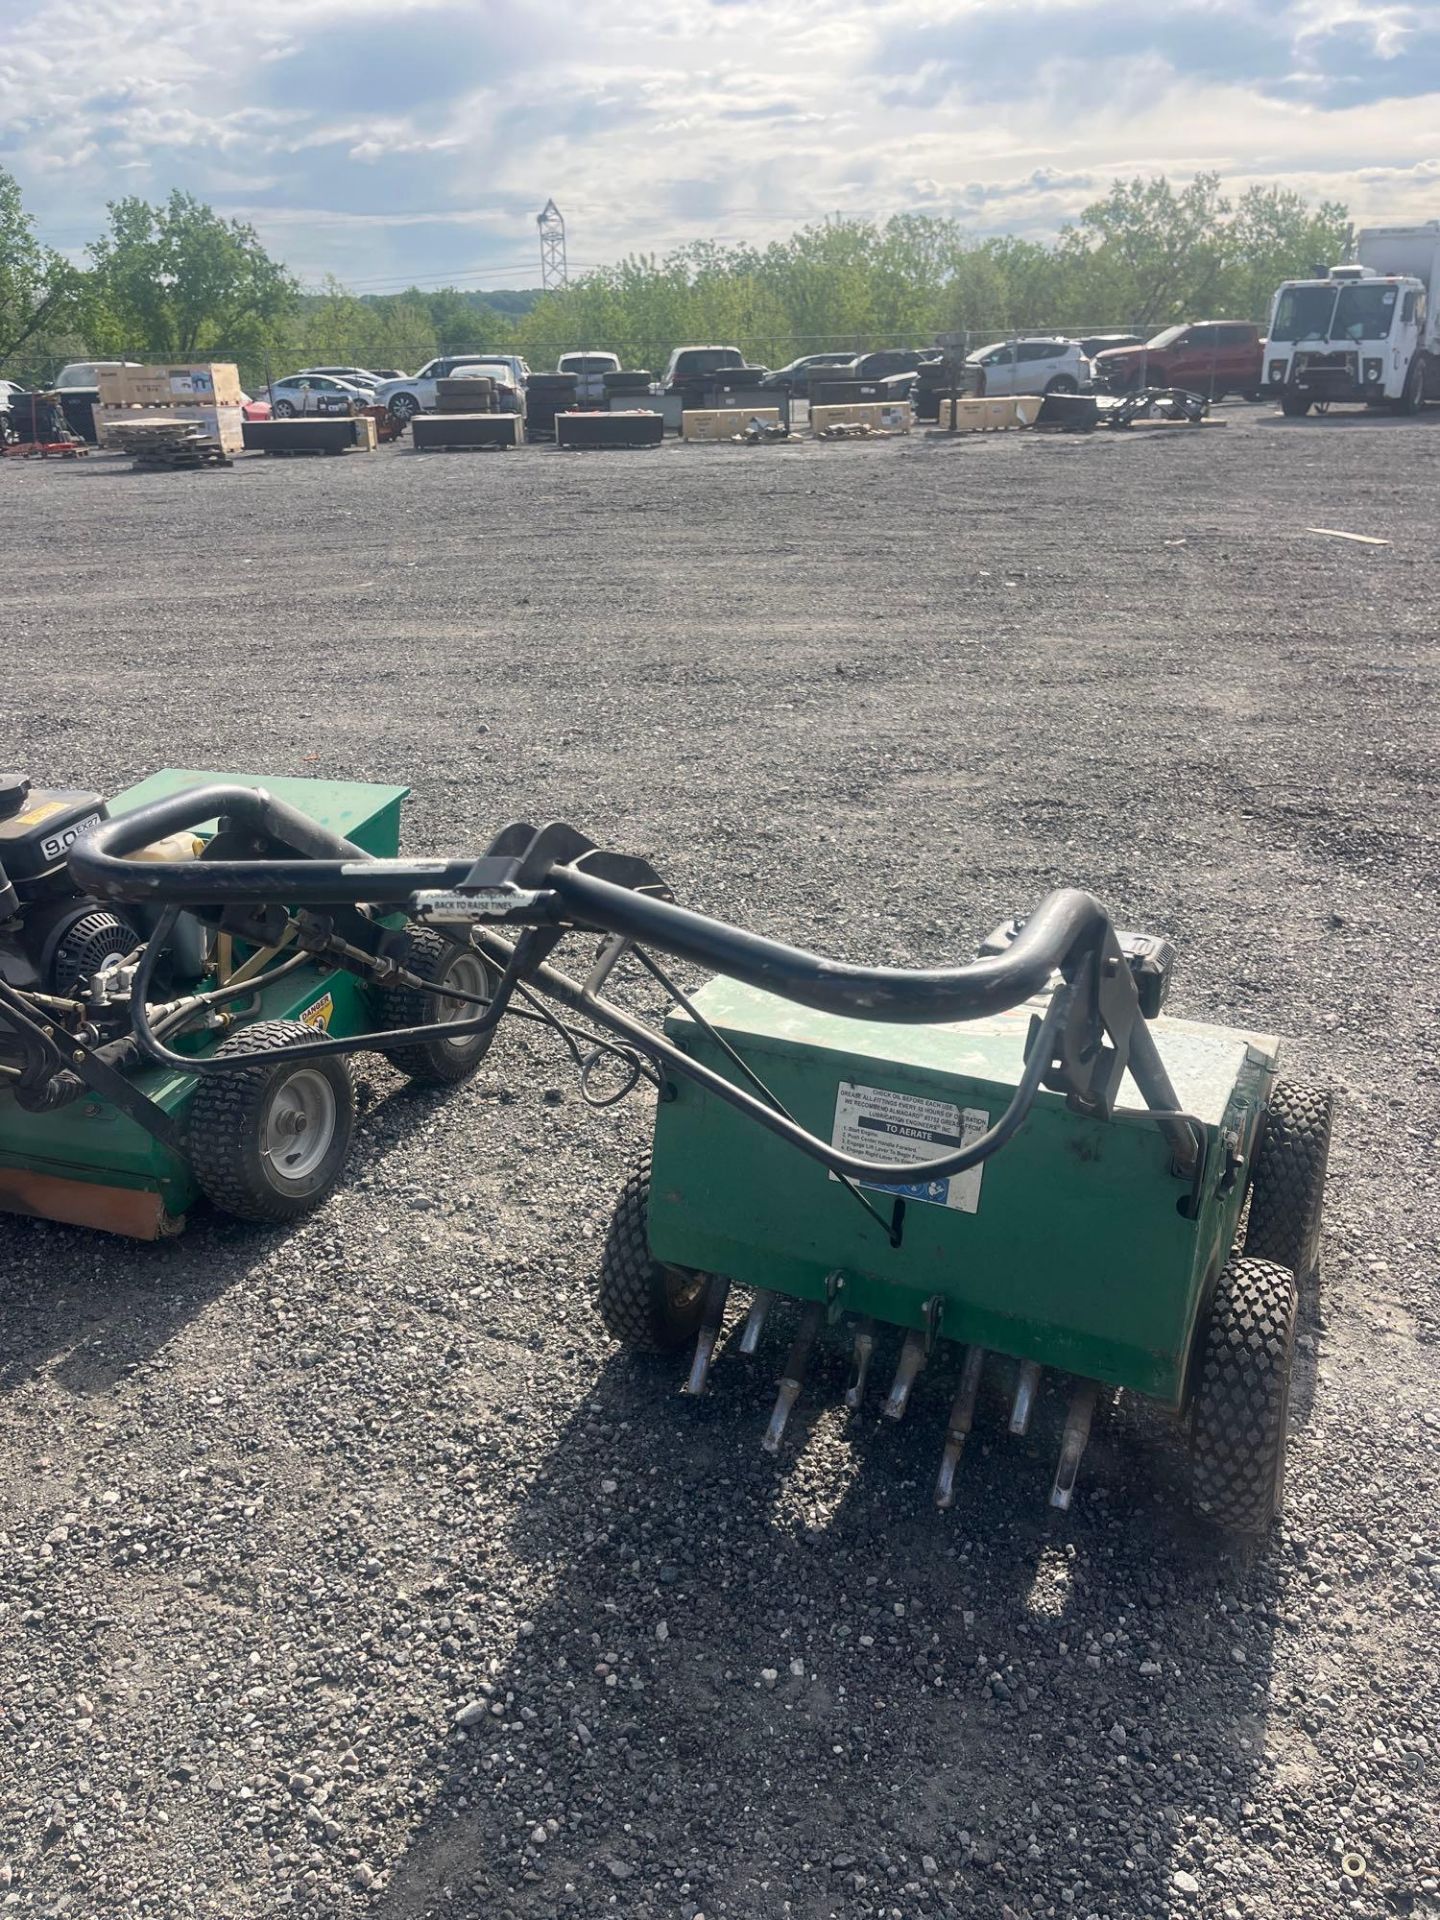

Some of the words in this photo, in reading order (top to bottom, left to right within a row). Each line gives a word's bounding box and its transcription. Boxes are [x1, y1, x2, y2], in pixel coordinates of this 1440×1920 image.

[45, 830, 77, 856] 9.0
[77, 817, 98, 834] EX27
[434, 901, 455, 909] BACK
[456, 901, 467, 909] TO
[468, 902, 488, 910] RAISE
[491, 902, 512, 910] TINES
[302, 995, 329, 1020] DANGER
[872, 1089, 891, 1097] CHECK
[902, 1095, 924, 1103] BEFORE
[924, 1107, 944, 1115] HOURS
[885, 1123, 898, 1133] TO
[899, 1126, 933, 1140] AERATE
